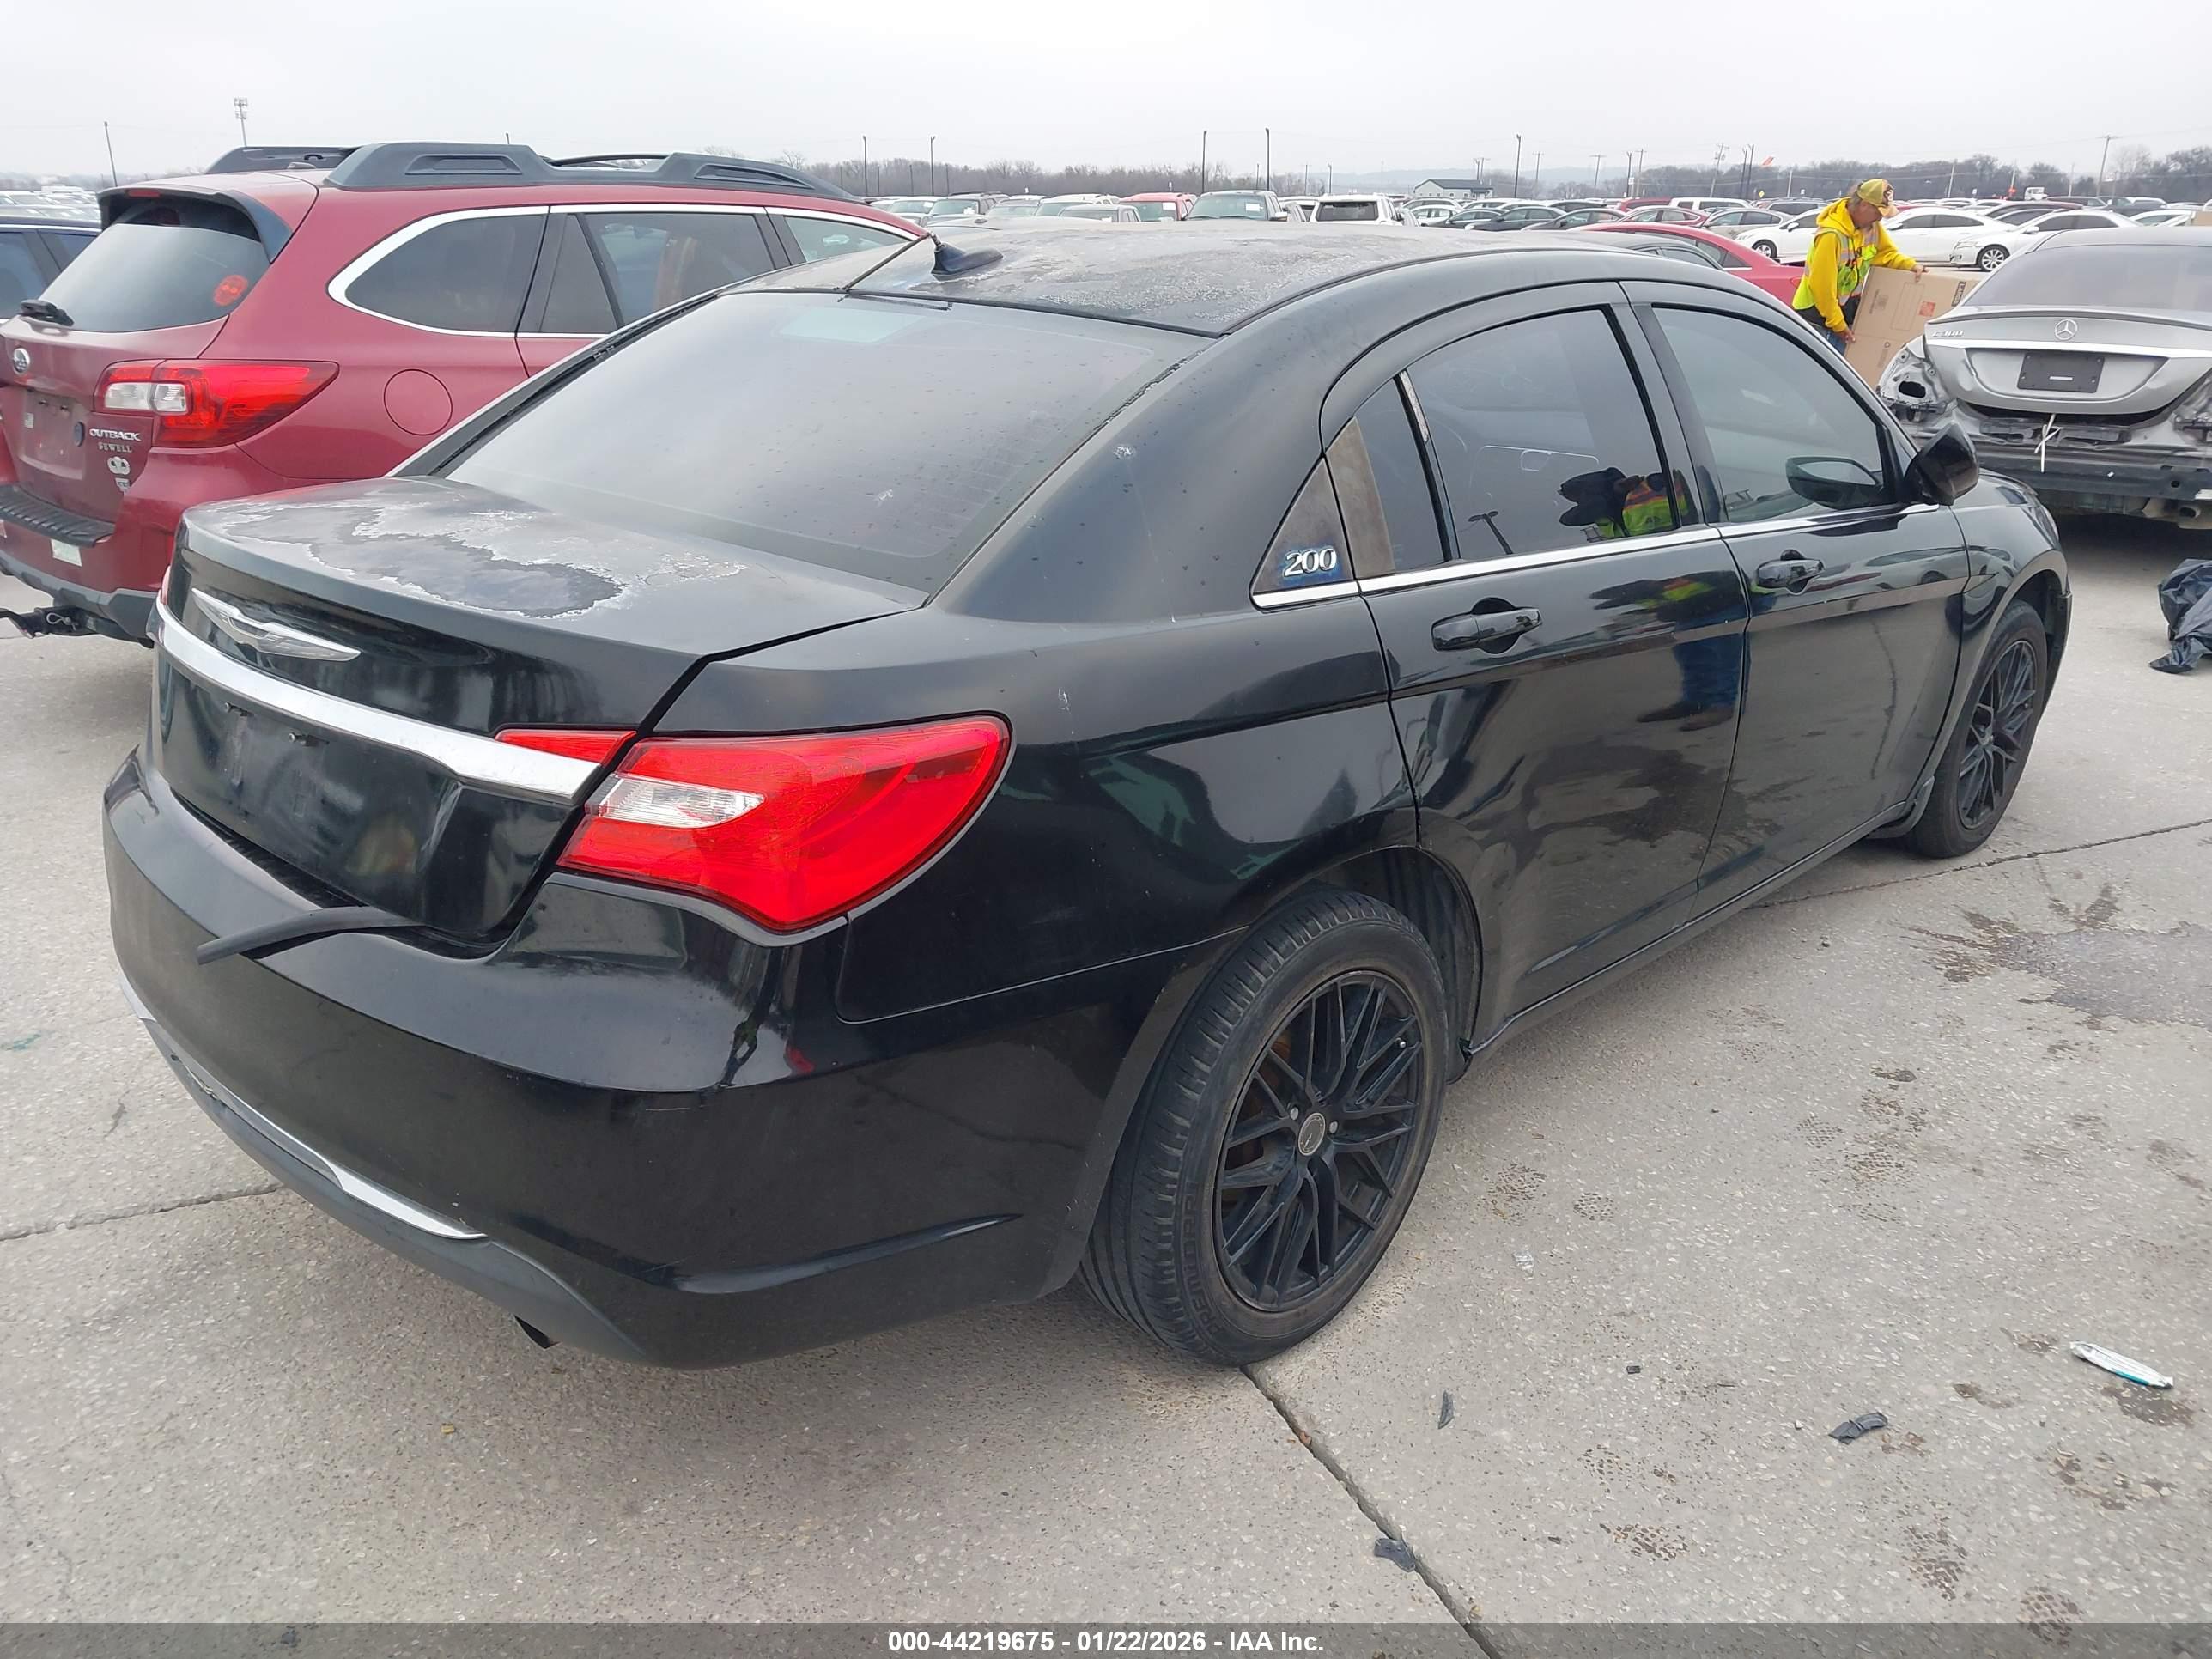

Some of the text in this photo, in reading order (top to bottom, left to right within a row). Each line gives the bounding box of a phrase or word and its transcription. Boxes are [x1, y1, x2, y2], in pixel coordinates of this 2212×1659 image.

[89, 428, 142, 441] OUTBACK
[98, 442, 132, 453] SEWELL
[1285, 548, 1337, 576] 200
